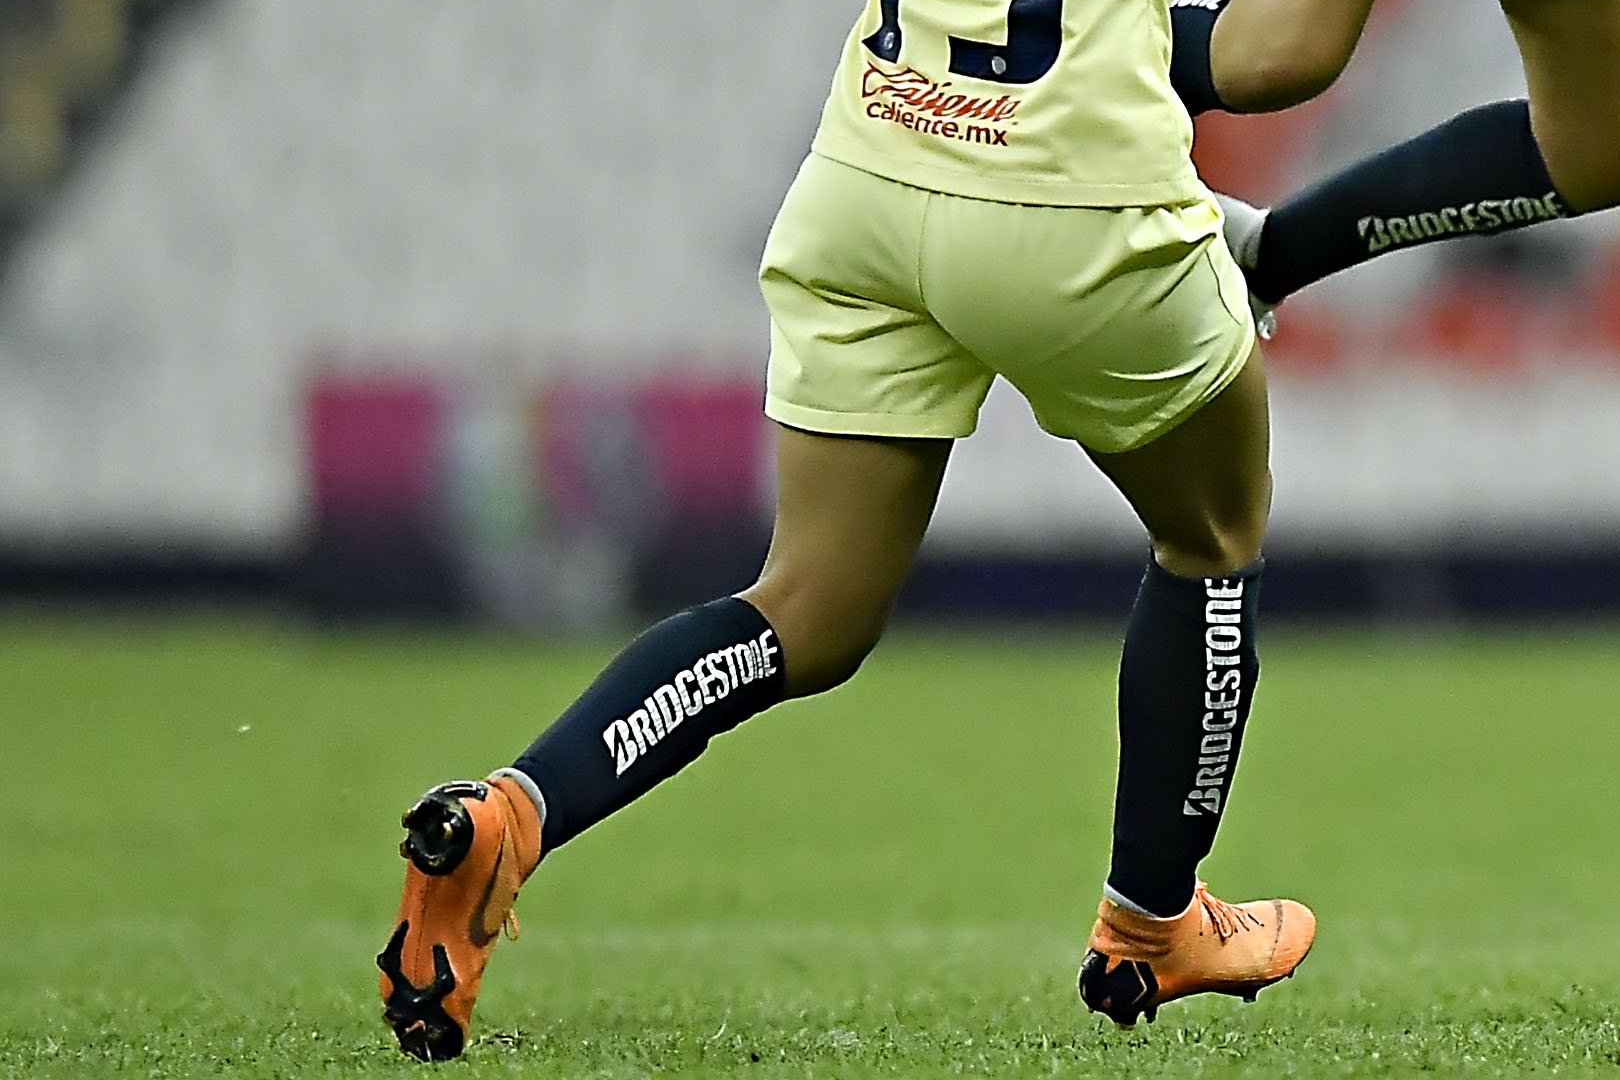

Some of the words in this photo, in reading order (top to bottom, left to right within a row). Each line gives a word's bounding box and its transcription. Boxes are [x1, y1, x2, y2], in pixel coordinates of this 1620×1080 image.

[866, 100, 1009, 147] caliente.mx
[602, 628, 778, 779] BRIDGESTONE
[1183, 577, 1244, 816] BRIDGESTONE
